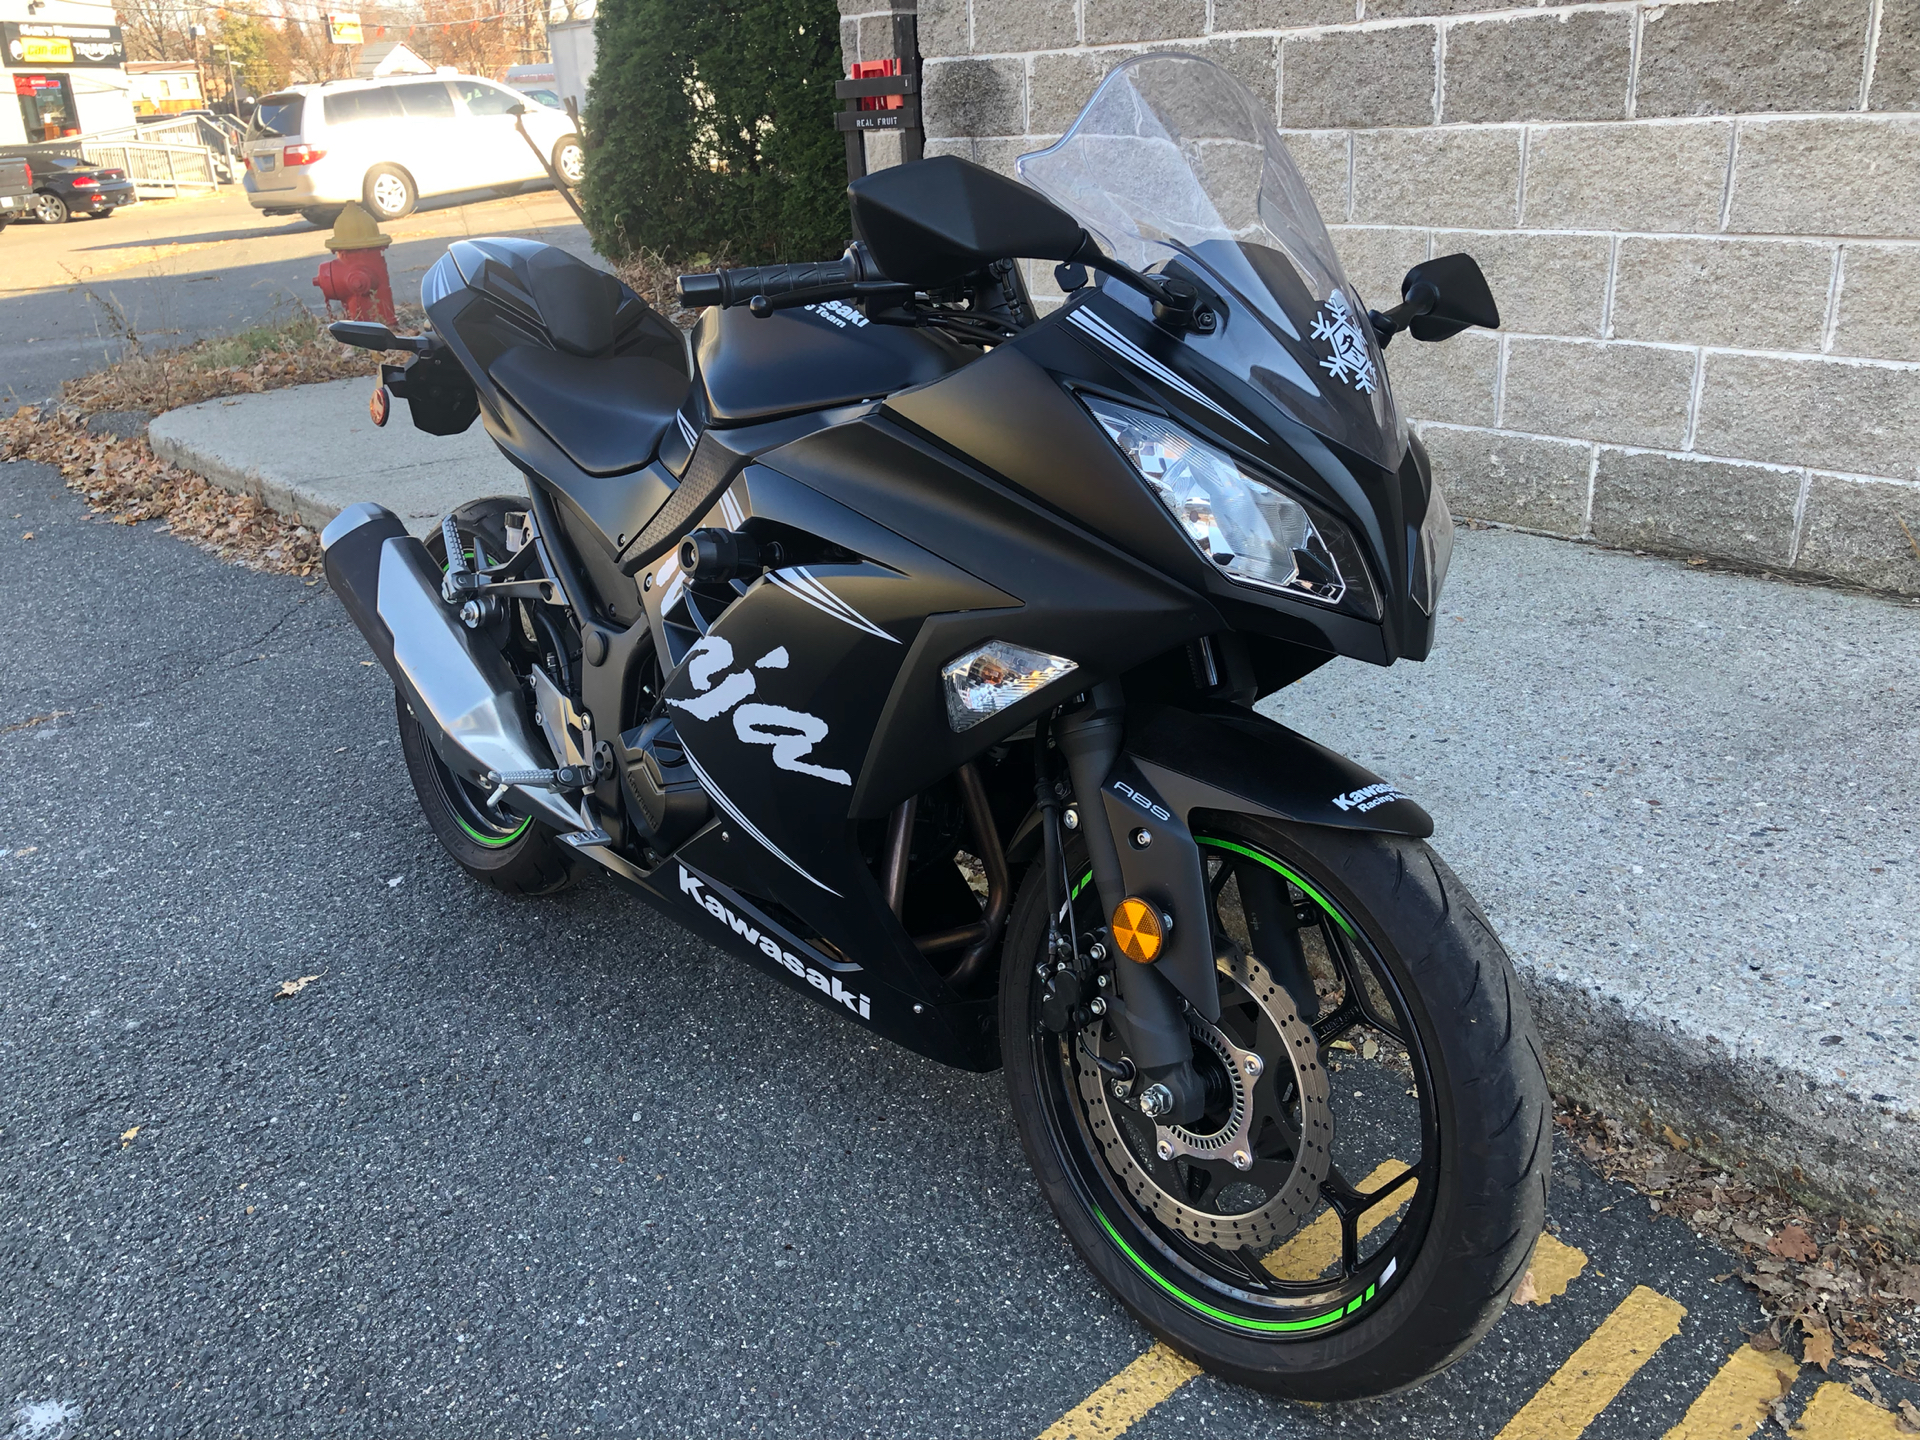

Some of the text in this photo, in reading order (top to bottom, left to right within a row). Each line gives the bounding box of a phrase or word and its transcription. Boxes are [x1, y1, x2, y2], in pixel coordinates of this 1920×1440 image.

[856, 116, 898, 128] REAL FRUIT
[815, 306, 847, 328] Team
[821, 300, 870, 328] saki
[1113, 781, 1171, 821] ABS
[1357, 793, 1395, 812] Racing
[678, 865, 871, 1020] Kawasaki
